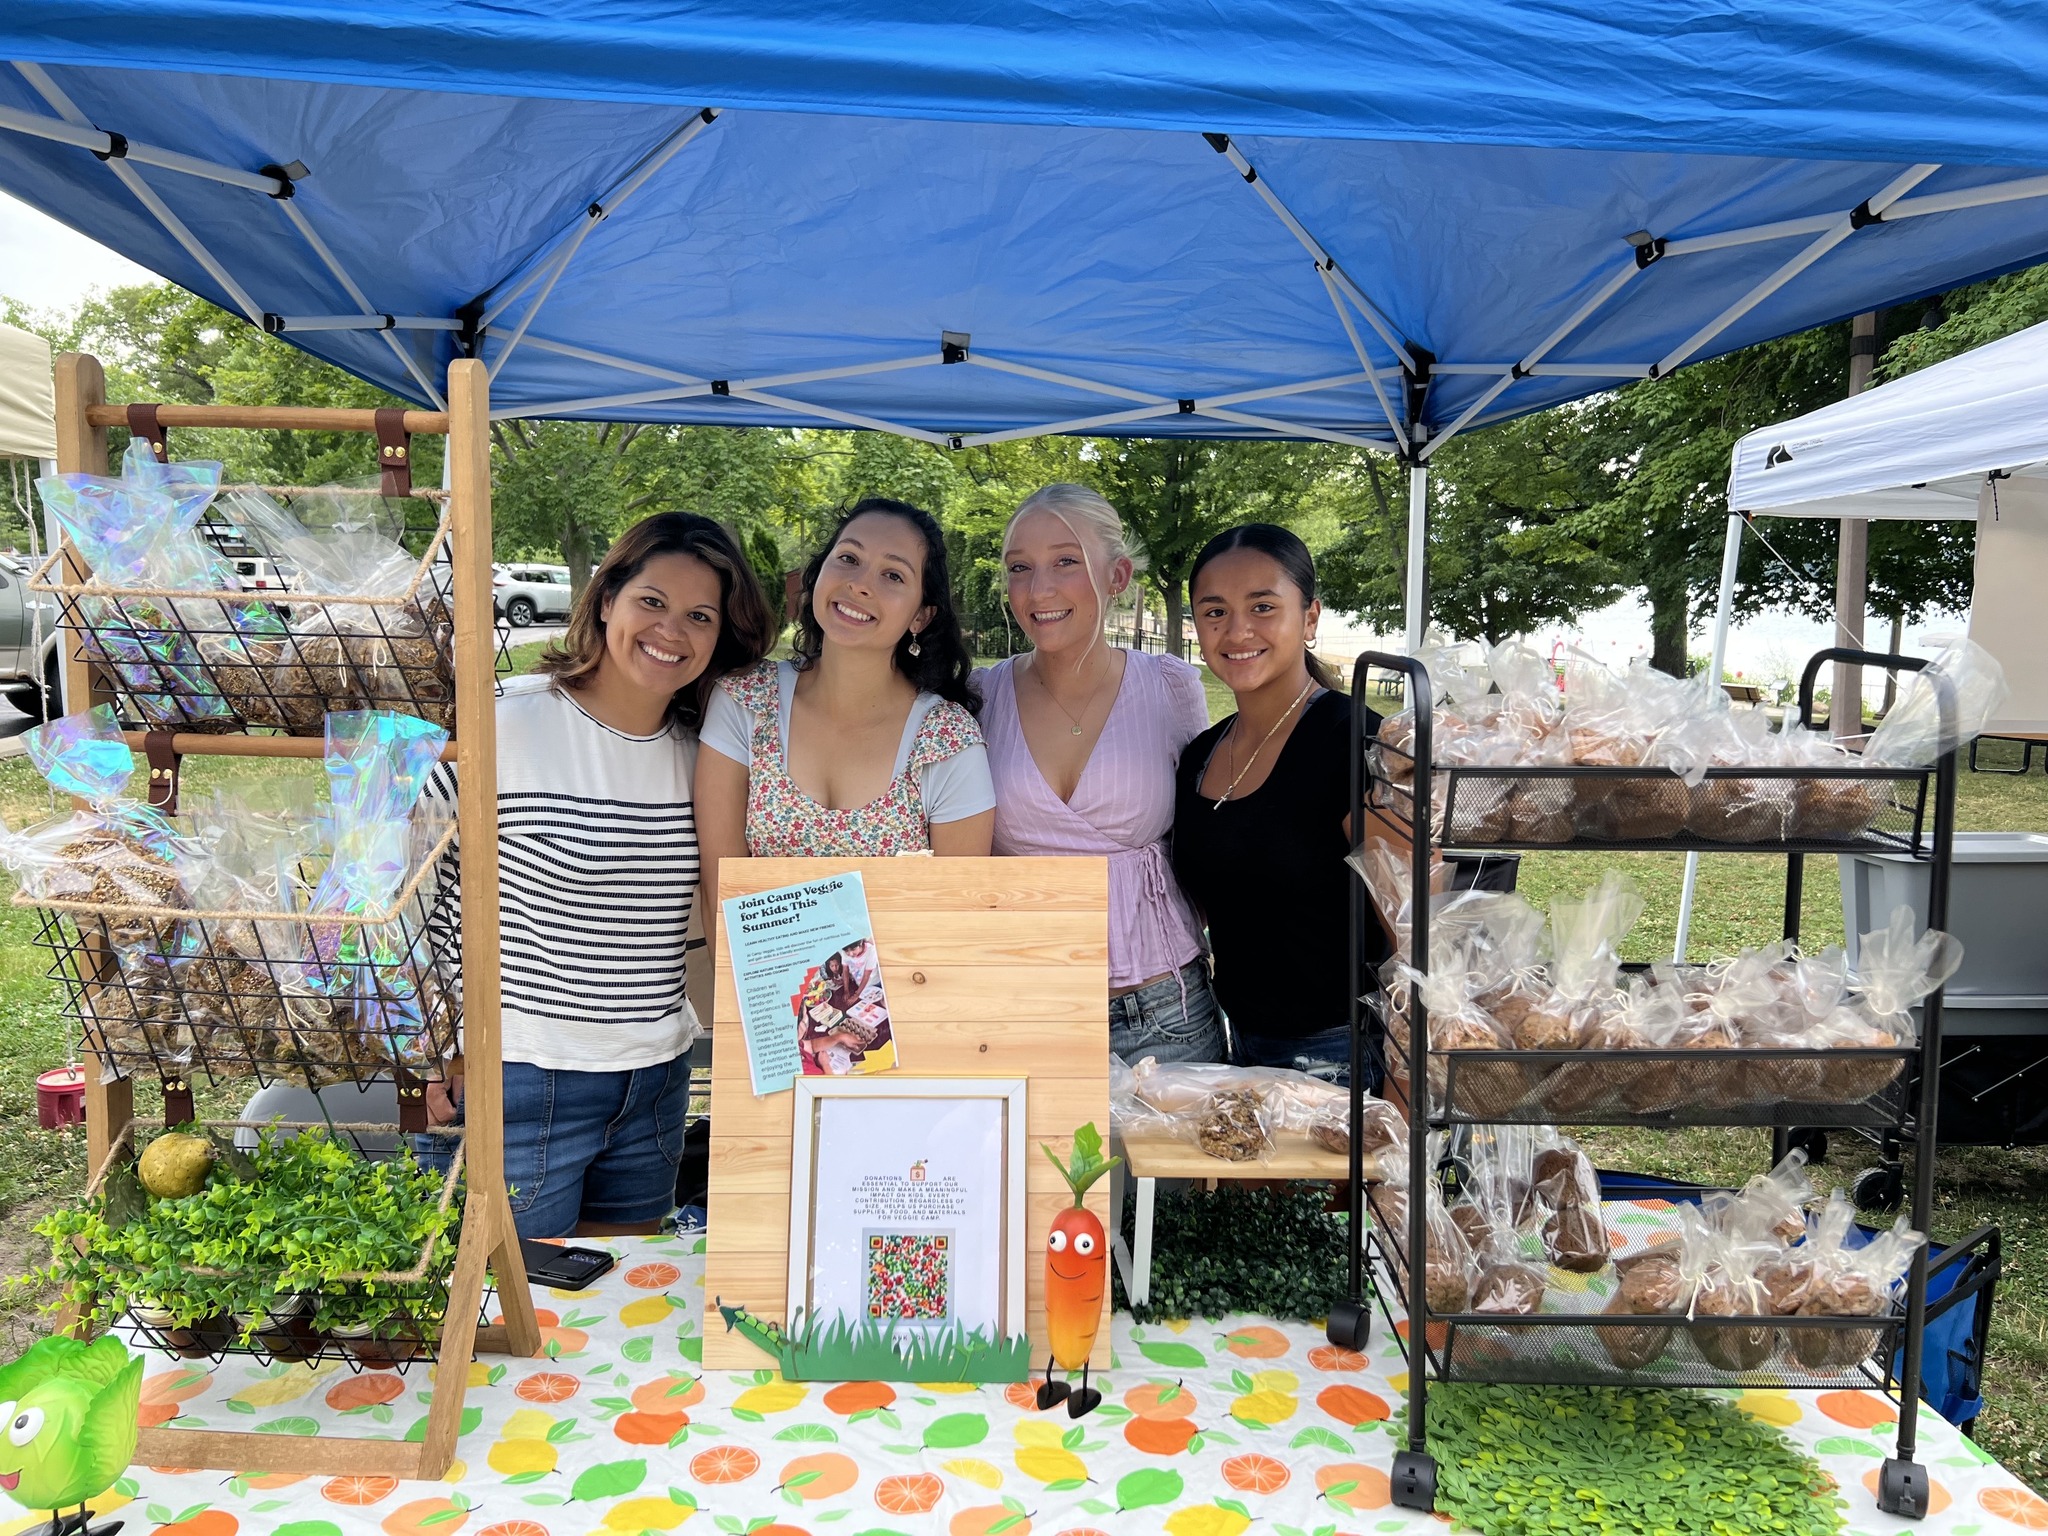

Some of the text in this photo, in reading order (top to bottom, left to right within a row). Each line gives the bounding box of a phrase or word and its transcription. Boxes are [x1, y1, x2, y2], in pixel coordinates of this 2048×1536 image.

[739, 881, 843, 909] Join Camp Veggie
[741, 899, 817, 921] for Kids This
[743, 913, 800, 933] Summer!
[748, 992, 774, 1001] participate
[749, 999, 773, 1008] hands-on
[751, 1005, 780, 1015] experiences
[752, 1014, 772, 1023] planting
[758, 1039, 793, 1050] understanding
[768, 1046, 797, 1055] importance
[767, 1055, 787, 1063] nutrition
[761, 1064, 783, 1072] enjoying
